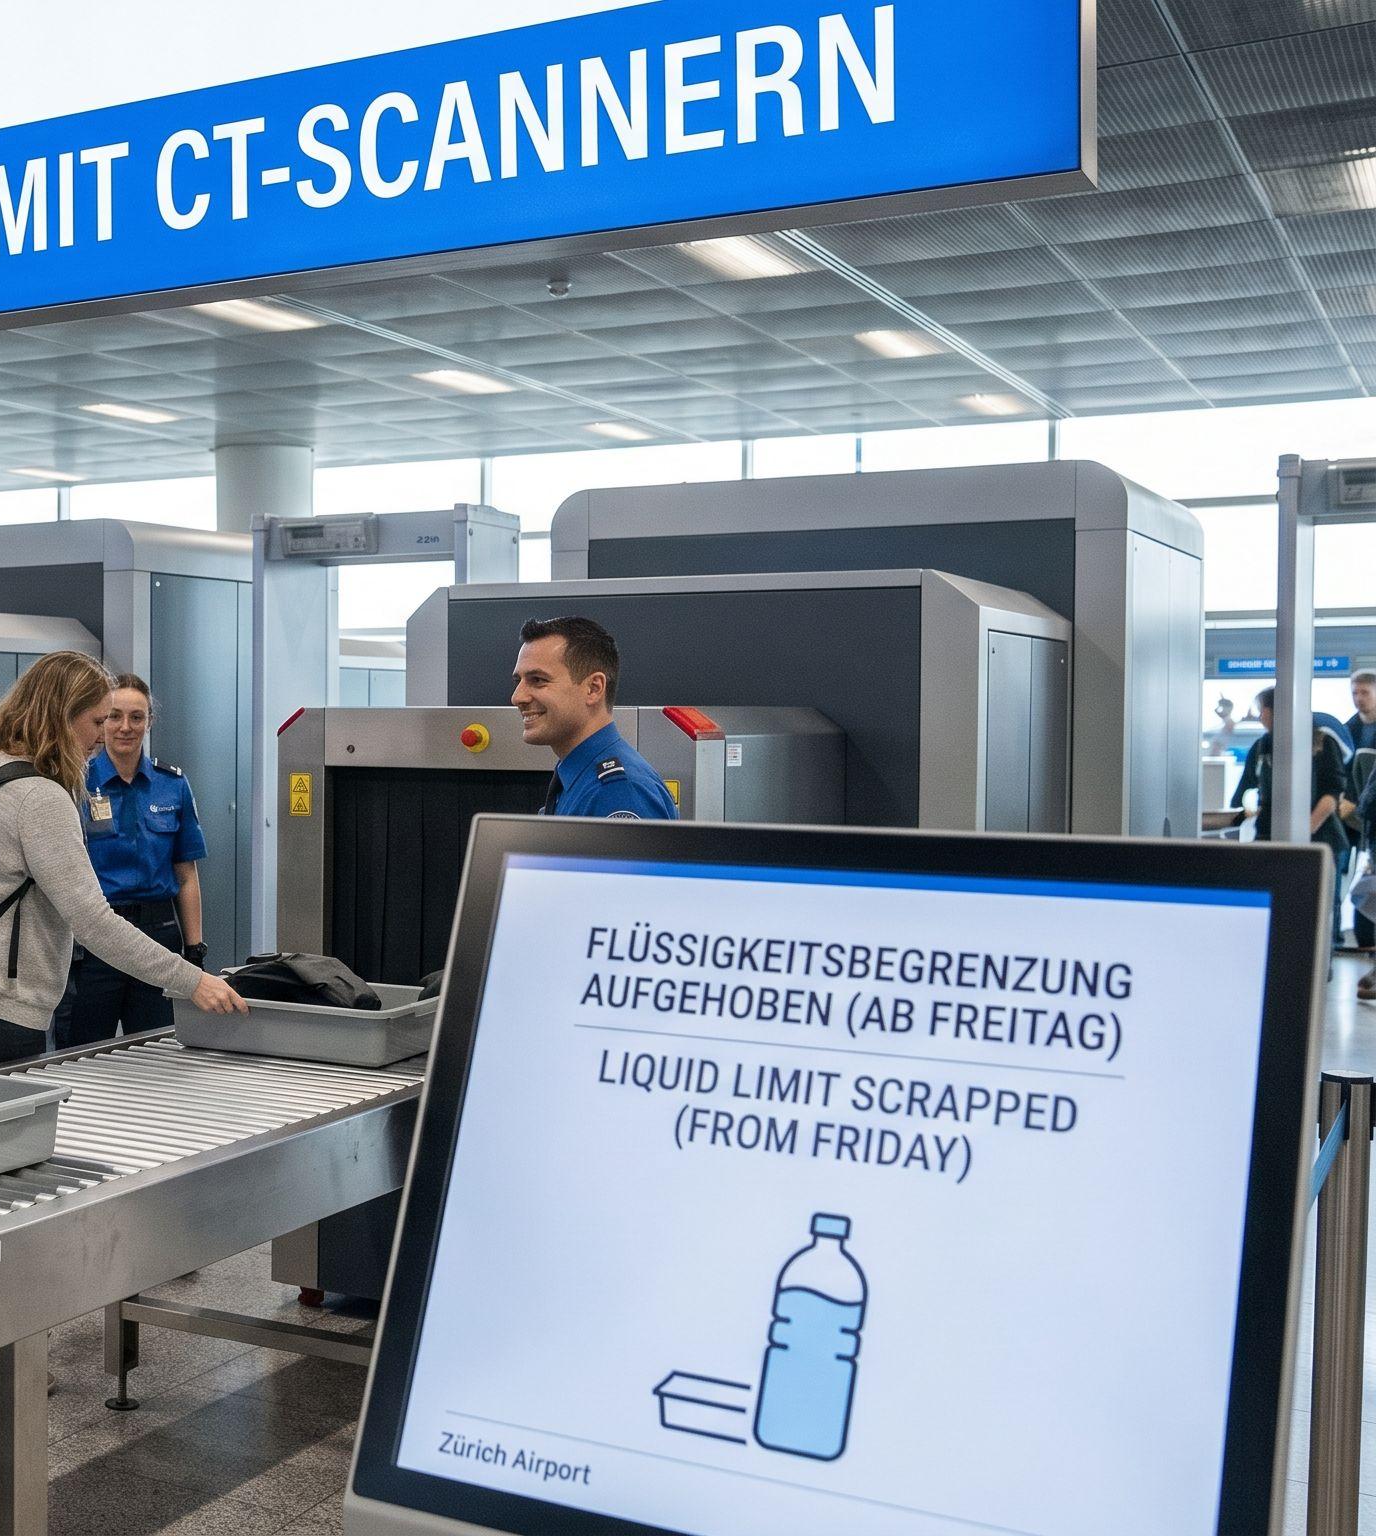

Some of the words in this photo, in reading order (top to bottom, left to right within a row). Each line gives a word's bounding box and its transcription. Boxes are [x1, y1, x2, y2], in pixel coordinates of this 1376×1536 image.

[156, 4, 895, 230] CT-SCANNERN
[586, 922, 1132, 1000] FLÜSSIGKEITSBEGRENZUNG
[580, 973, 833, 1027] AUFGEHOBEN
[847, 992, 915, 1038] (AB
[929, 1001, 1122, 1062] FREITAG)
[599, 1049, 719, 1098] LIQUID
[733, 1063, 841, 1107] LIMIT
[851, 1076, 1077, 1133] SCRAPPED
[675, 1104, 798, 1155] (FROM
[812, 1122, 972, 1184] FRIDAY)
[438, 1431, 507, 1466] Zürich
[512, 1449, 591, 1486] Airport
